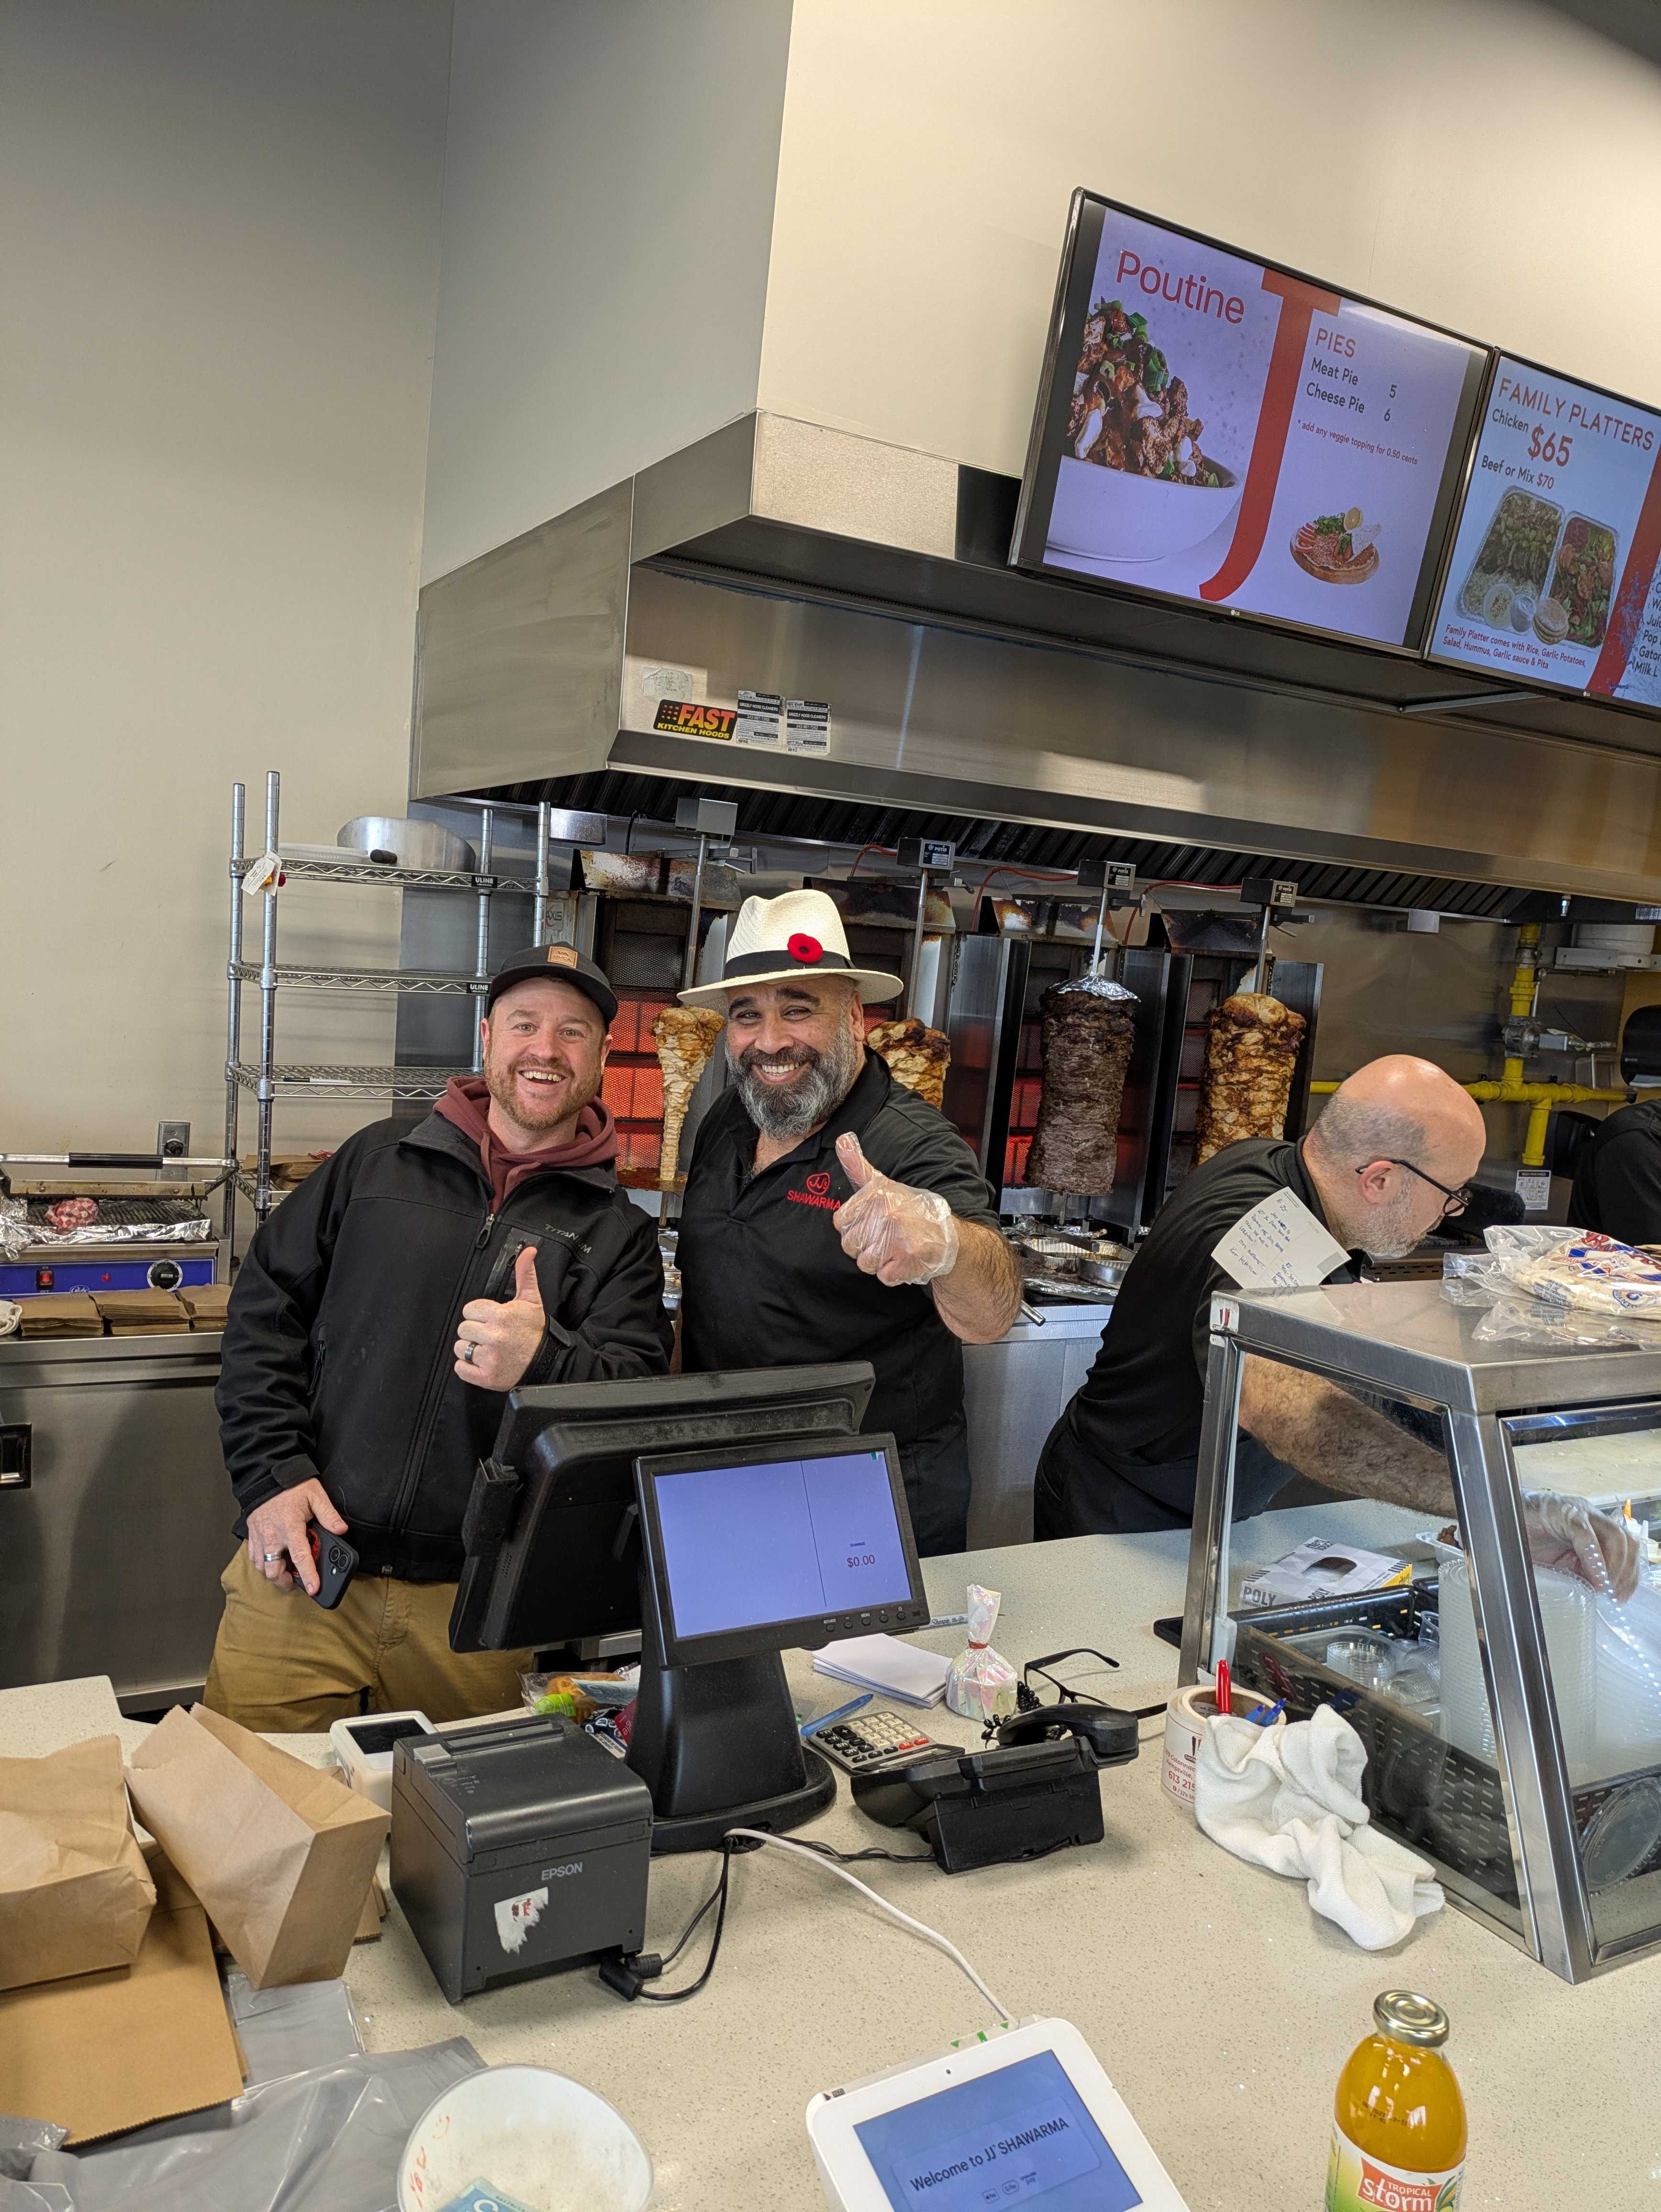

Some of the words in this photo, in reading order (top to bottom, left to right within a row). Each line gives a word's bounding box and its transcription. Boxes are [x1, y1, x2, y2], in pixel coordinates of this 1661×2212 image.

[1116, 249, 1244, 324] Poutine
[1316, 328, 1356, 358] PIES
[1311, 357, 1340, 380] Meat
[1342, 367, 1359, 386] Pie
[1389, 384, 1397, 398] 5
[1307, 382, 1345, 407] Cheese
[1349, 396, 1365, 413] Pie
[1384, 409, 1391, 422] 6
[1498, 377, 1566, 418] FAMILY
[1569, 403, 1654, 451] PLATTERS
[1492, 408, 1528, 433] Chicken
[1302, 422, 1314, 431] add
[1316, 427, 1328, 438] any
[1329, 430, 1350, 444] veggie
[1351, 437, 1374, 453] topping
[1376, 444, 1386, 454] for
[1387, 448, 1401, 459] 0.50
[1401, 453, 1418, 465] cents
[1527, 423, 1573, 467] $65
[1481, 454, 1505, 473] Beef
[1505, 466, 1516, 476] or
[1517, 466, 1535, 484] Mix
[1536, 472, 1554, 489] $70
[1446, 624, 1467, 639] Family
[1467, 630, 1489, 642] Platter
[1490, 637, 1510, 647] comes
[1511, 640, 1525, 651] with
[1526, 644, 1539, 656] Rice,
[1541, 648, 1558, 659] Garlic
[1560, 653, 1586, 668] Potatoes,
[1643, 630, 1658, 643] Pop
[1443, 636, 1462, 650] Salad,
[1463, 641, 1491, 657] Hummus,
[1493, 648, 1511, 660] Garlic
[1512, 654, 1529, 664] sauce
[1537, 659, 1549, 669] Pita
[1635, 661, 1652, 675] Milk
[657, 722, 697, 735] KITCHEN
[699, 728, 730, 739] HOODS
[678, 704, 735, 732] FAST
[787, 1190, 841, 1210] SHAWARMA
[544, 1223, 592, 1254] TITANIUM
[847, 1555, 875, 1568] $0.00
[1244, 1586, 1276, 1606] POLY
[1308, 1587, 1331, 1599] POLY
[1169, 1770, 1180, 1784] 613
[1182, 1779, 1196, 1792] 215
[542, 1862, 583, 1880] EPSON
[910, 2161, 969, 2191] Welcome
[969, 2155, 983, 2167] to
[1362, 2178, 1432, 2212] storm
[1388, 2182, 1431, 2197] TROPICAL
